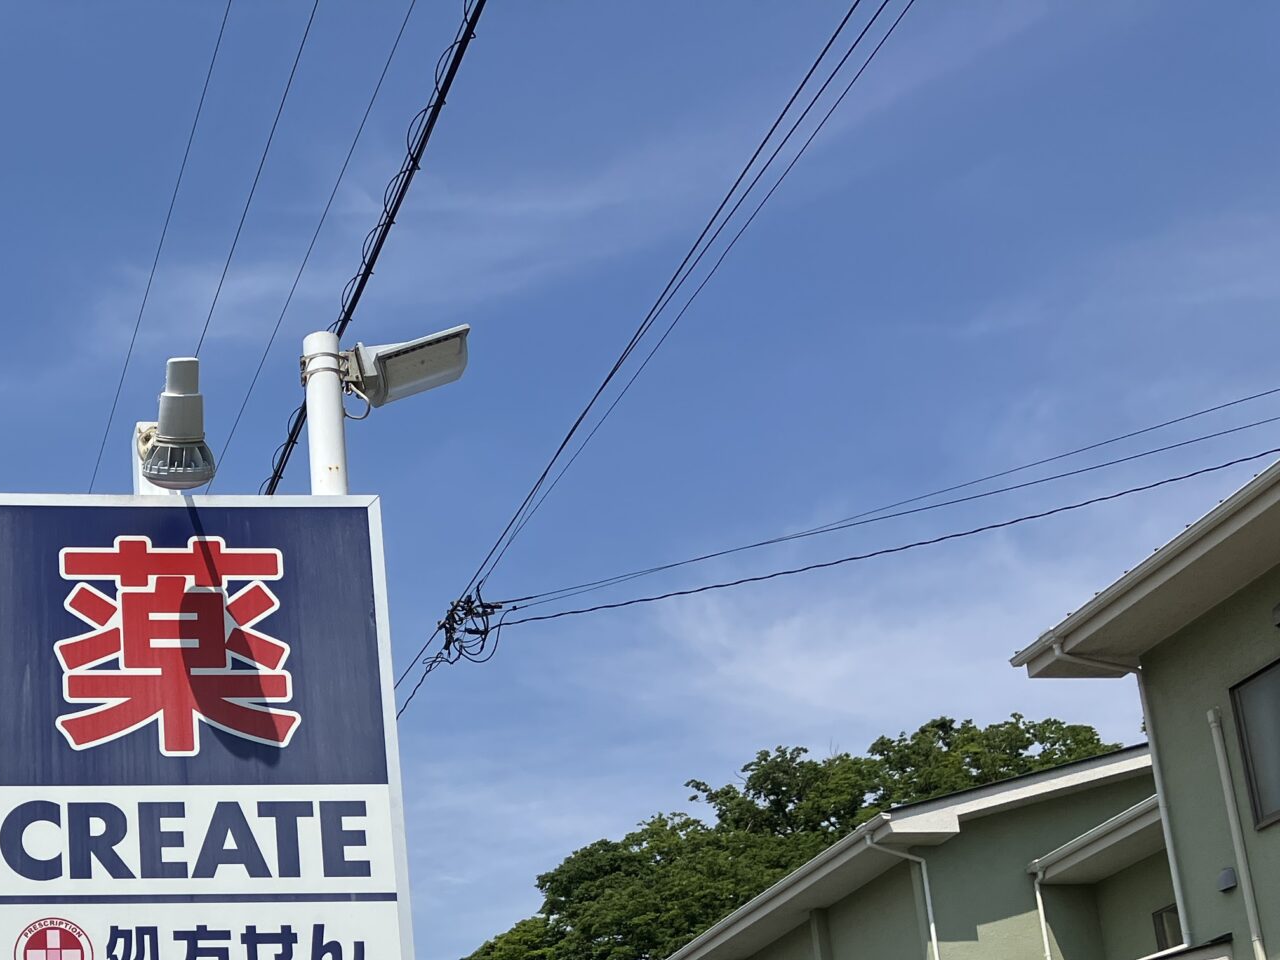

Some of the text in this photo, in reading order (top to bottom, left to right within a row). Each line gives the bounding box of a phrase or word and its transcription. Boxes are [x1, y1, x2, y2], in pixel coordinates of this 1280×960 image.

[56, 537, 299, 755] 薬
[0, 799, 372, 881] CREATE
[24, 920, 83, 939] PRESCRIPTION
